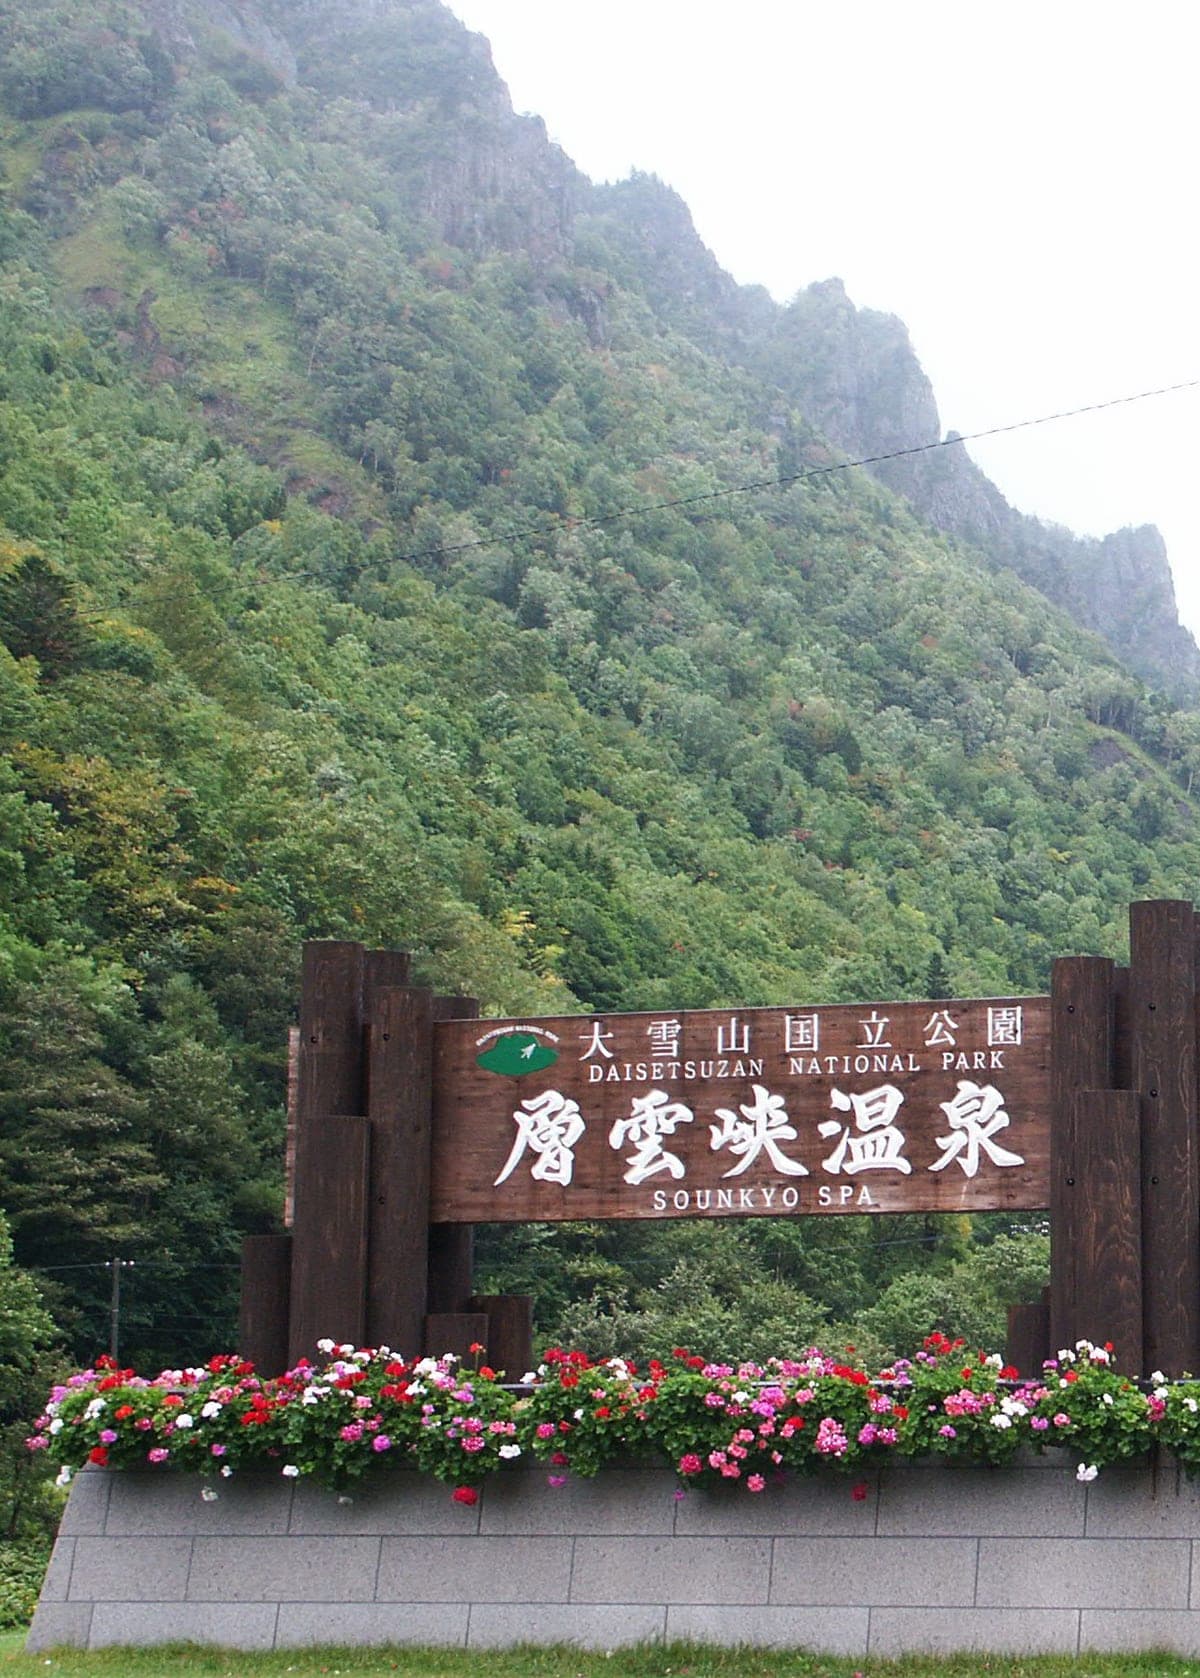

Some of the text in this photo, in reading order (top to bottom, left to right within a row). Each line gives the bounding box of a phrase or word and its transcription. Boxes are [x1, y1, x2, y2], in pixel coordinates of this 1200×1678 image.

[579, 1005, 1022, 1061] 大雪山国立公園
[589, 1050, 1005, 1083] DAISETSUZAN NATIONAL PARK
[653, 1185, 874, 1210] SOUNKYO SPA
